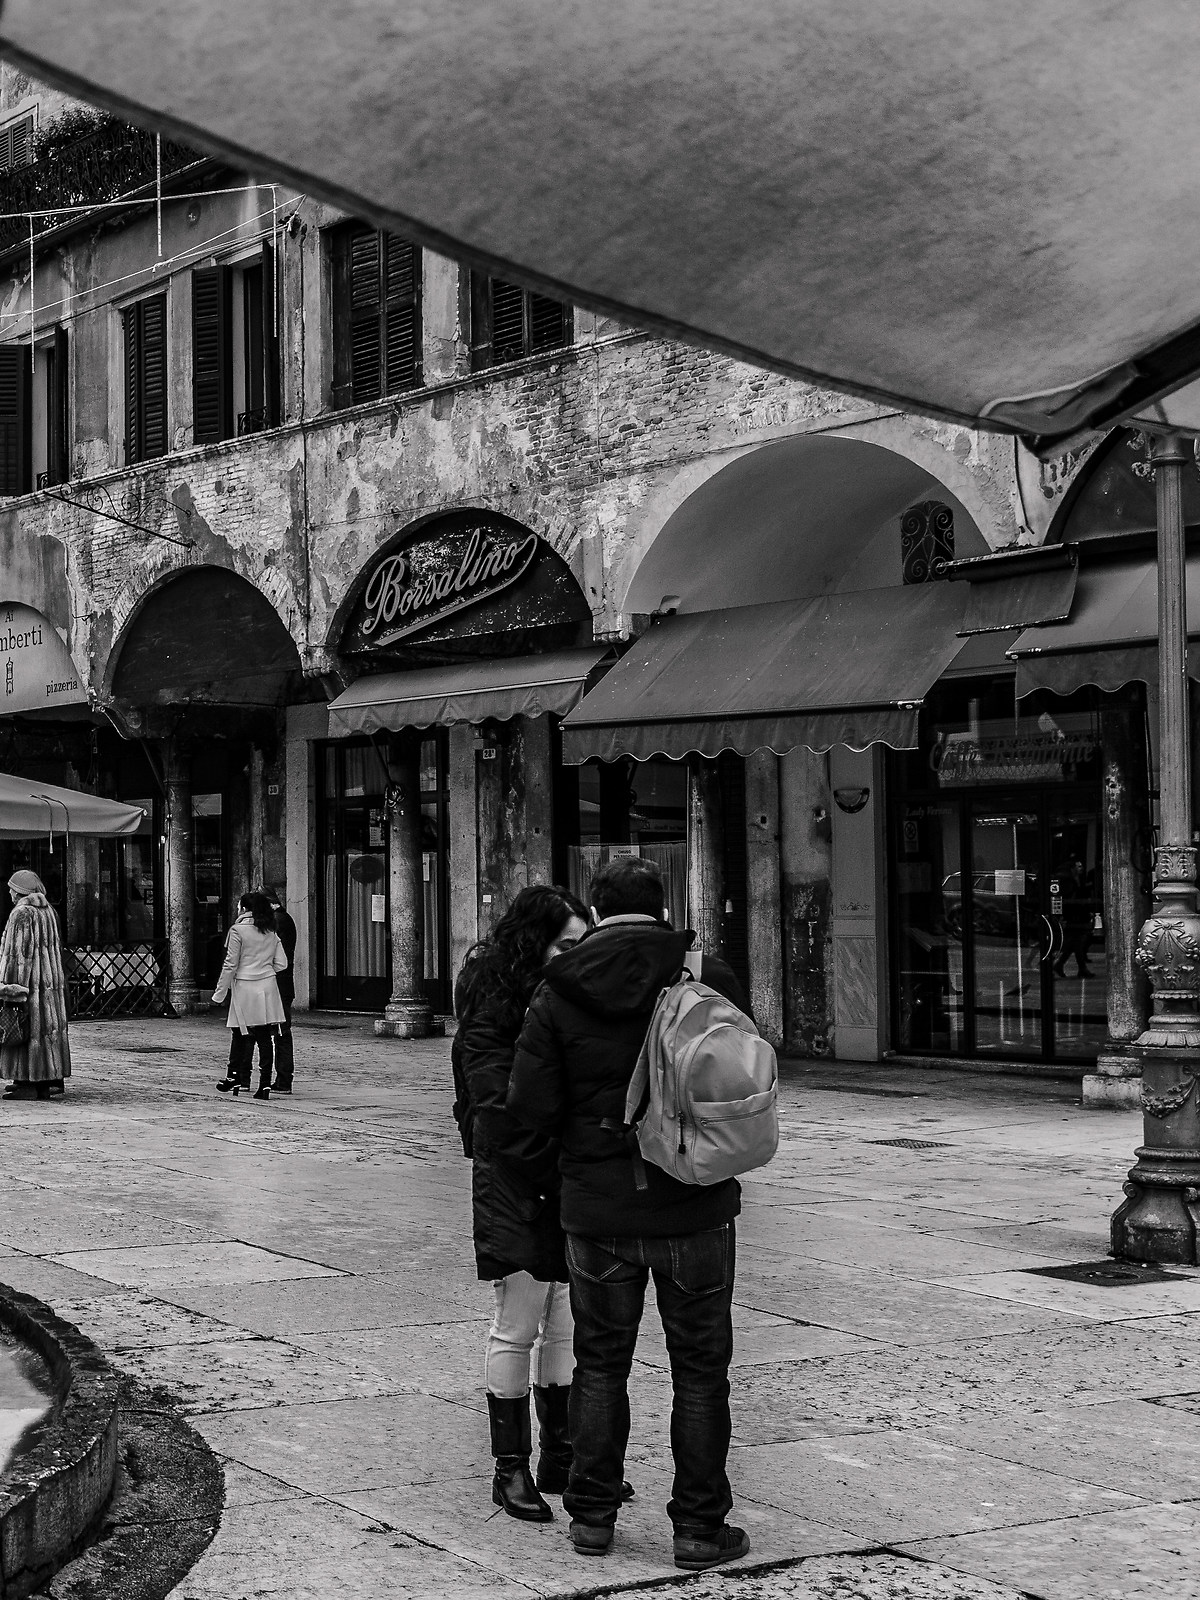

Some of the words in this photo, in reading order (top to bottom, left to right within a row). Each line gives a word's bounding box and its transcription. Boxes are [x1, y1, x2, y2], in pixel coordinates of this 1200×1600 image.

[362, 528, 538, 636] Borsalino
[5, 610, 14, 623] Ai
[46, 677, 78, 696] pizzeria
